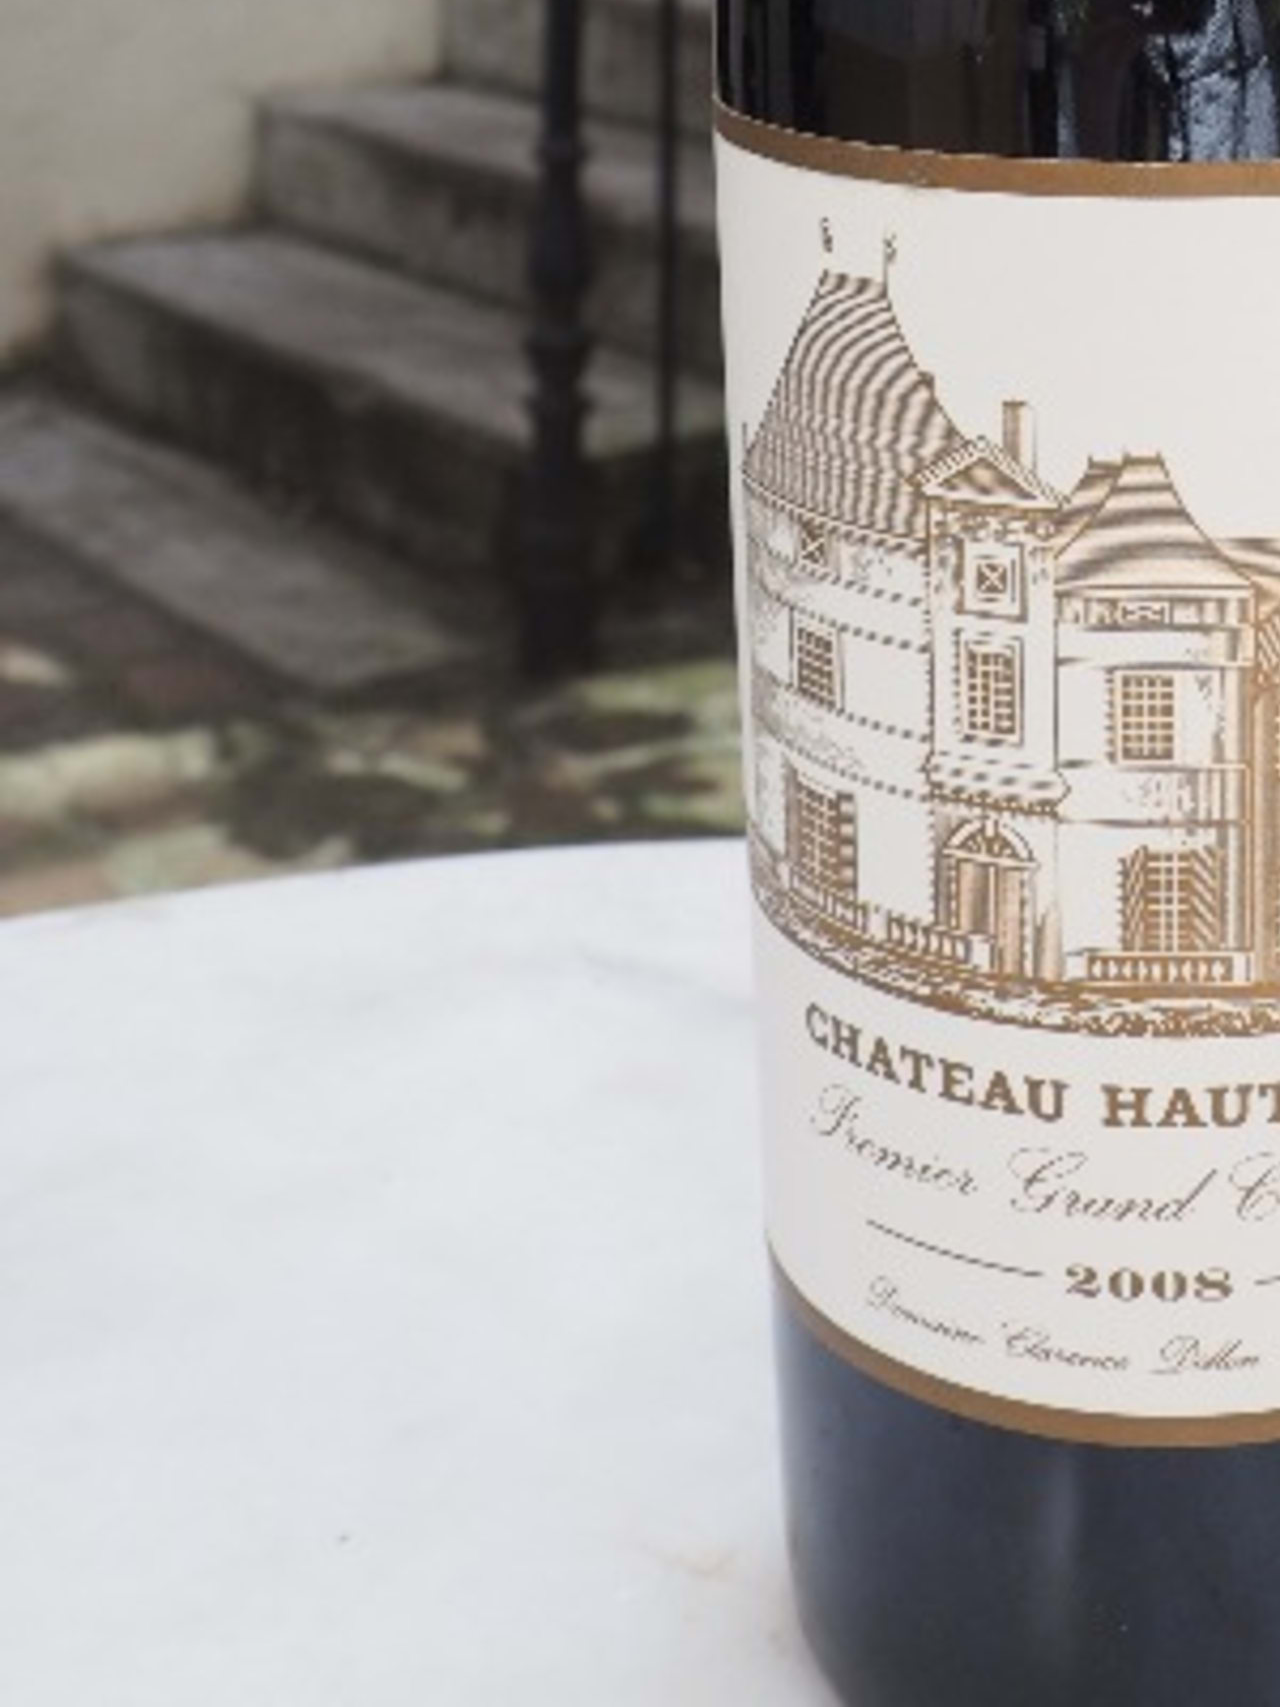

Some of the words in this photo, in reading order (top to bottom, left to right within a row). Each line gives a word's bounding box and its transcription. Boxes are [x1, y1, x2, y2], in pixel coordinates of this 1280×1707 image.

[805, 1002, 1069, 1122] CHATEAU
[809, 1083, 979, 1194] Premier
[1007, 1146, 1218, 1221] Grand
[1065, 1264, 1234, 1302] 2008
[1150, 1335, 1259, 1374] Dillon
